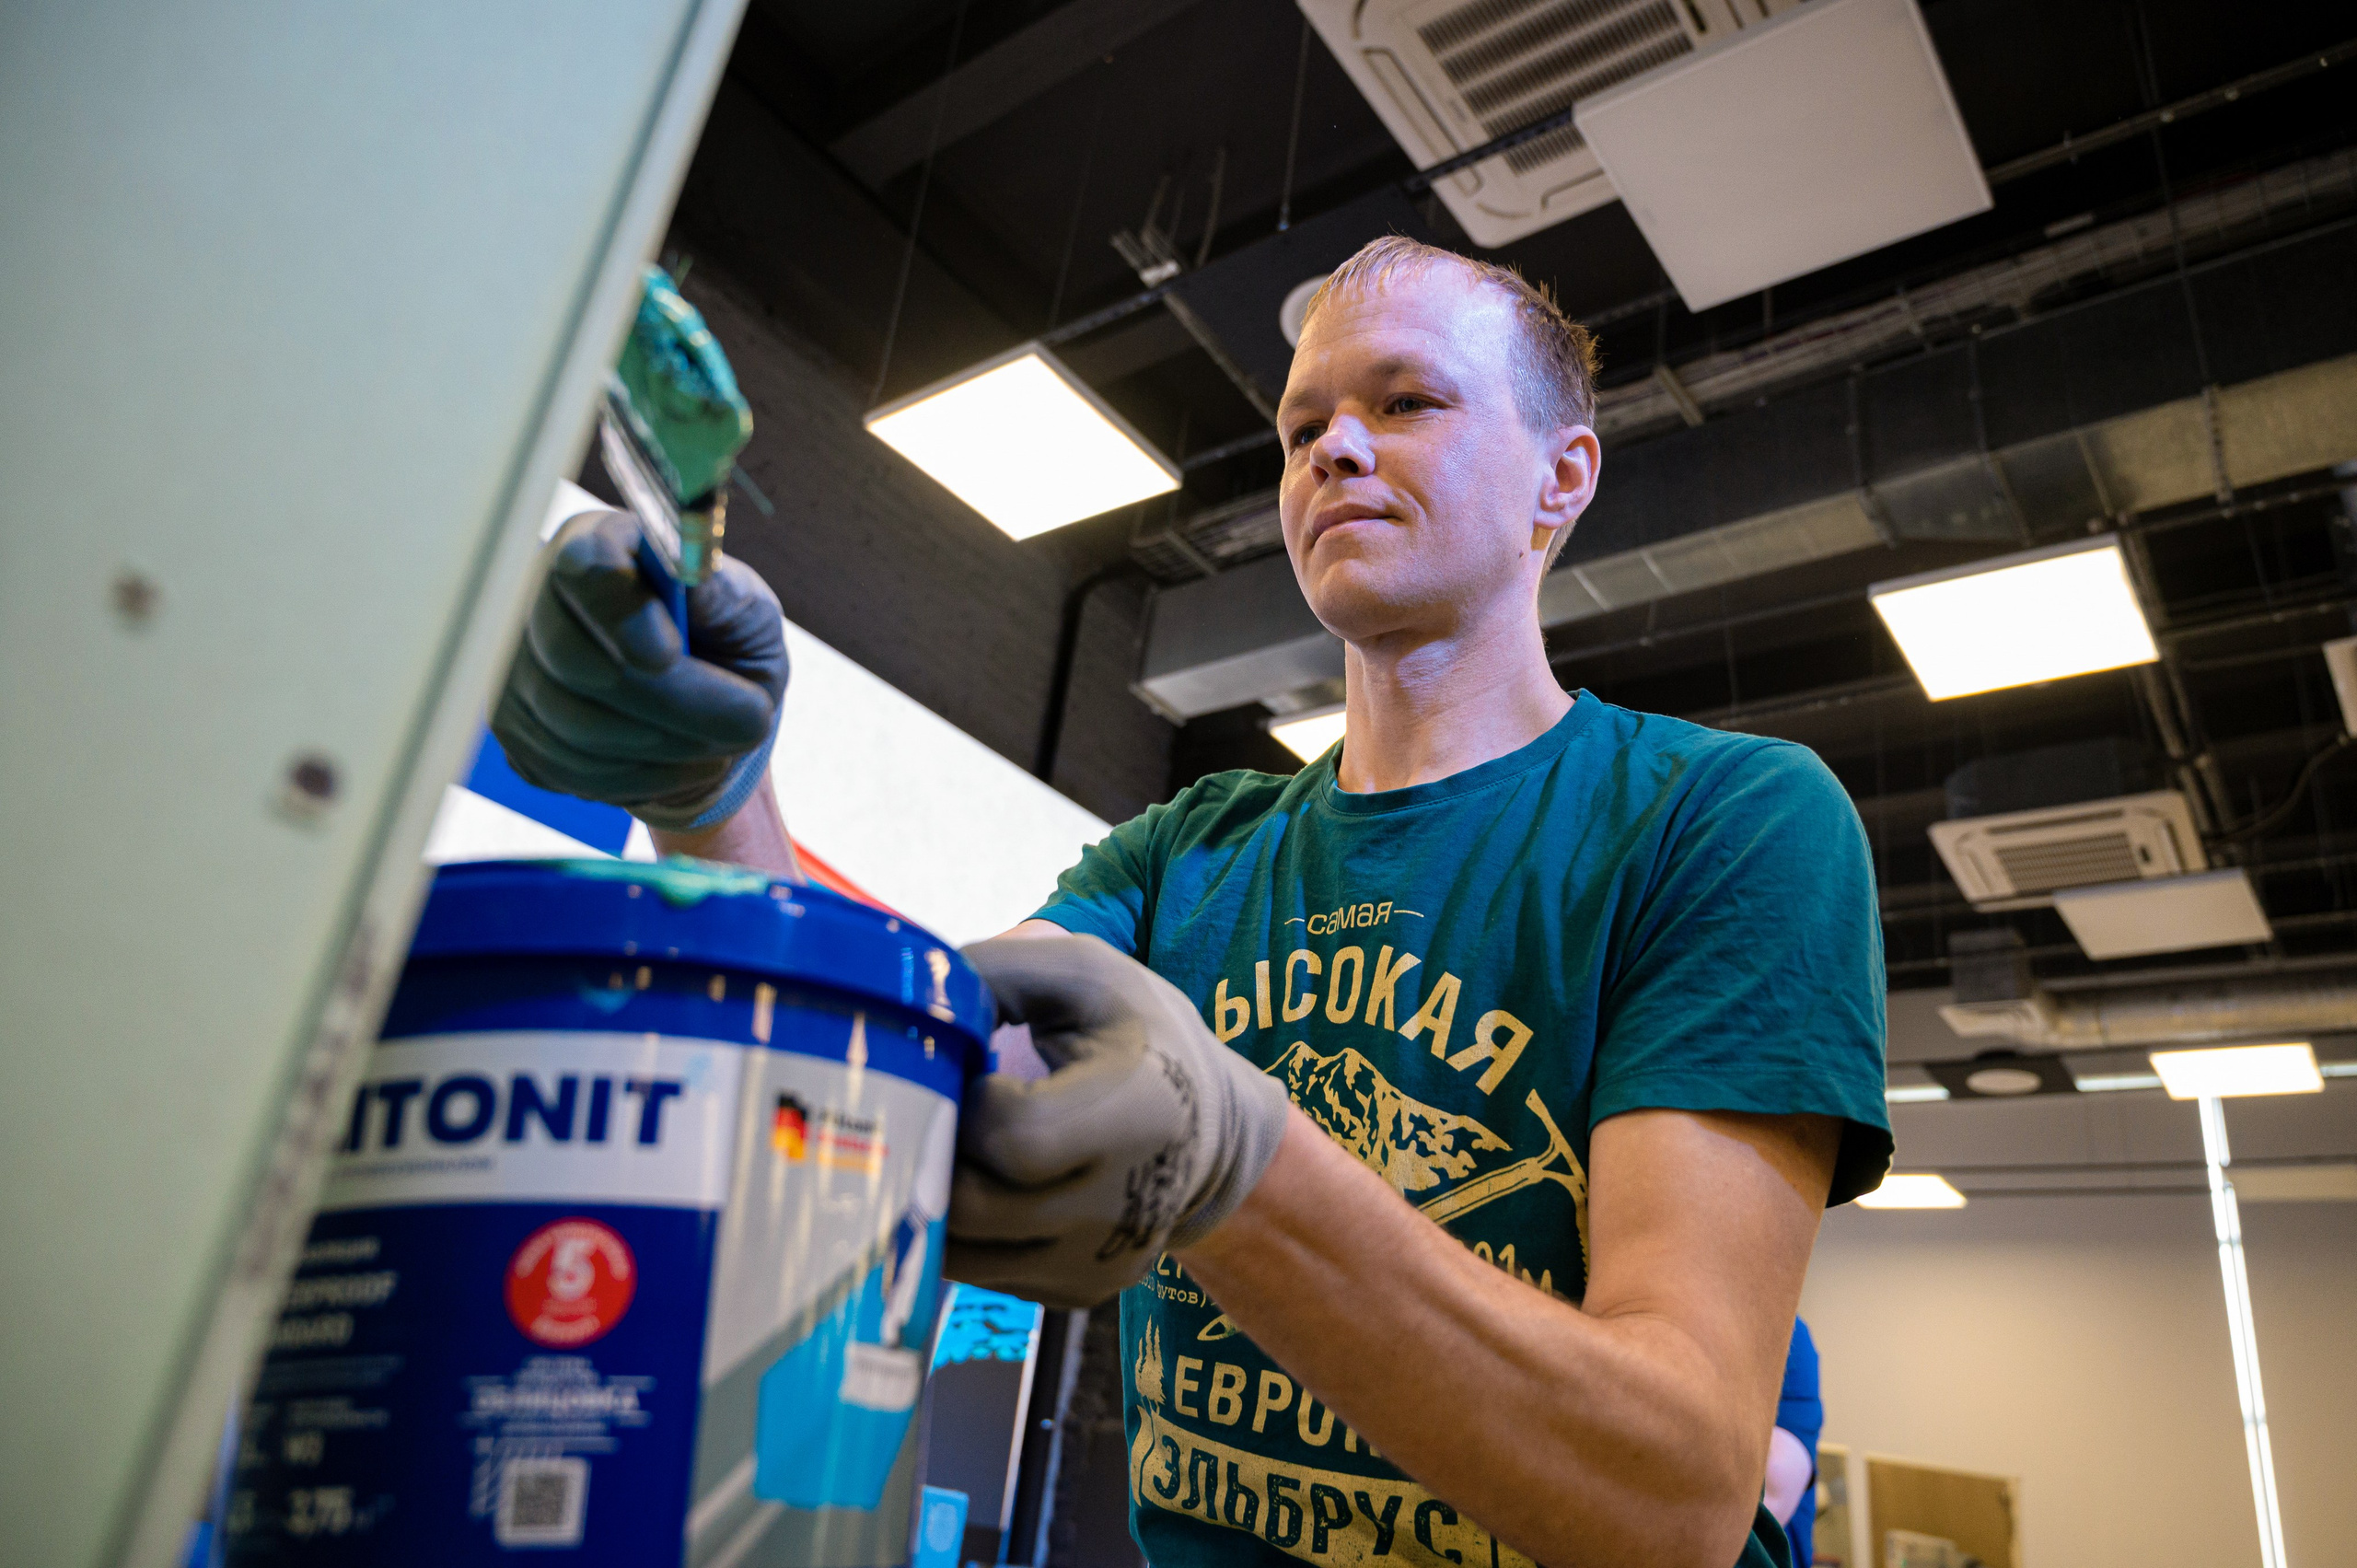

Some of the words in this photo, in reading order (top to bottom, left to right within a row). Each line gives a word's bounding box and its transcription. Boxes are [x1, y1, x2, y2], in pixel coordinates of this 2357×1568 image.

[1307, 901, 1393, 935] самая
[1214, 945, 1534, 1097] ЫСОКАЯ
[343, 1072, 682, 1152] ITONIT
[547, 1238, 598, 1300] 5
[1174, 1354, 1381, 1457] ЕВРО
[1153, 1434, 1463, 1565] ЭЛЬБРУС
